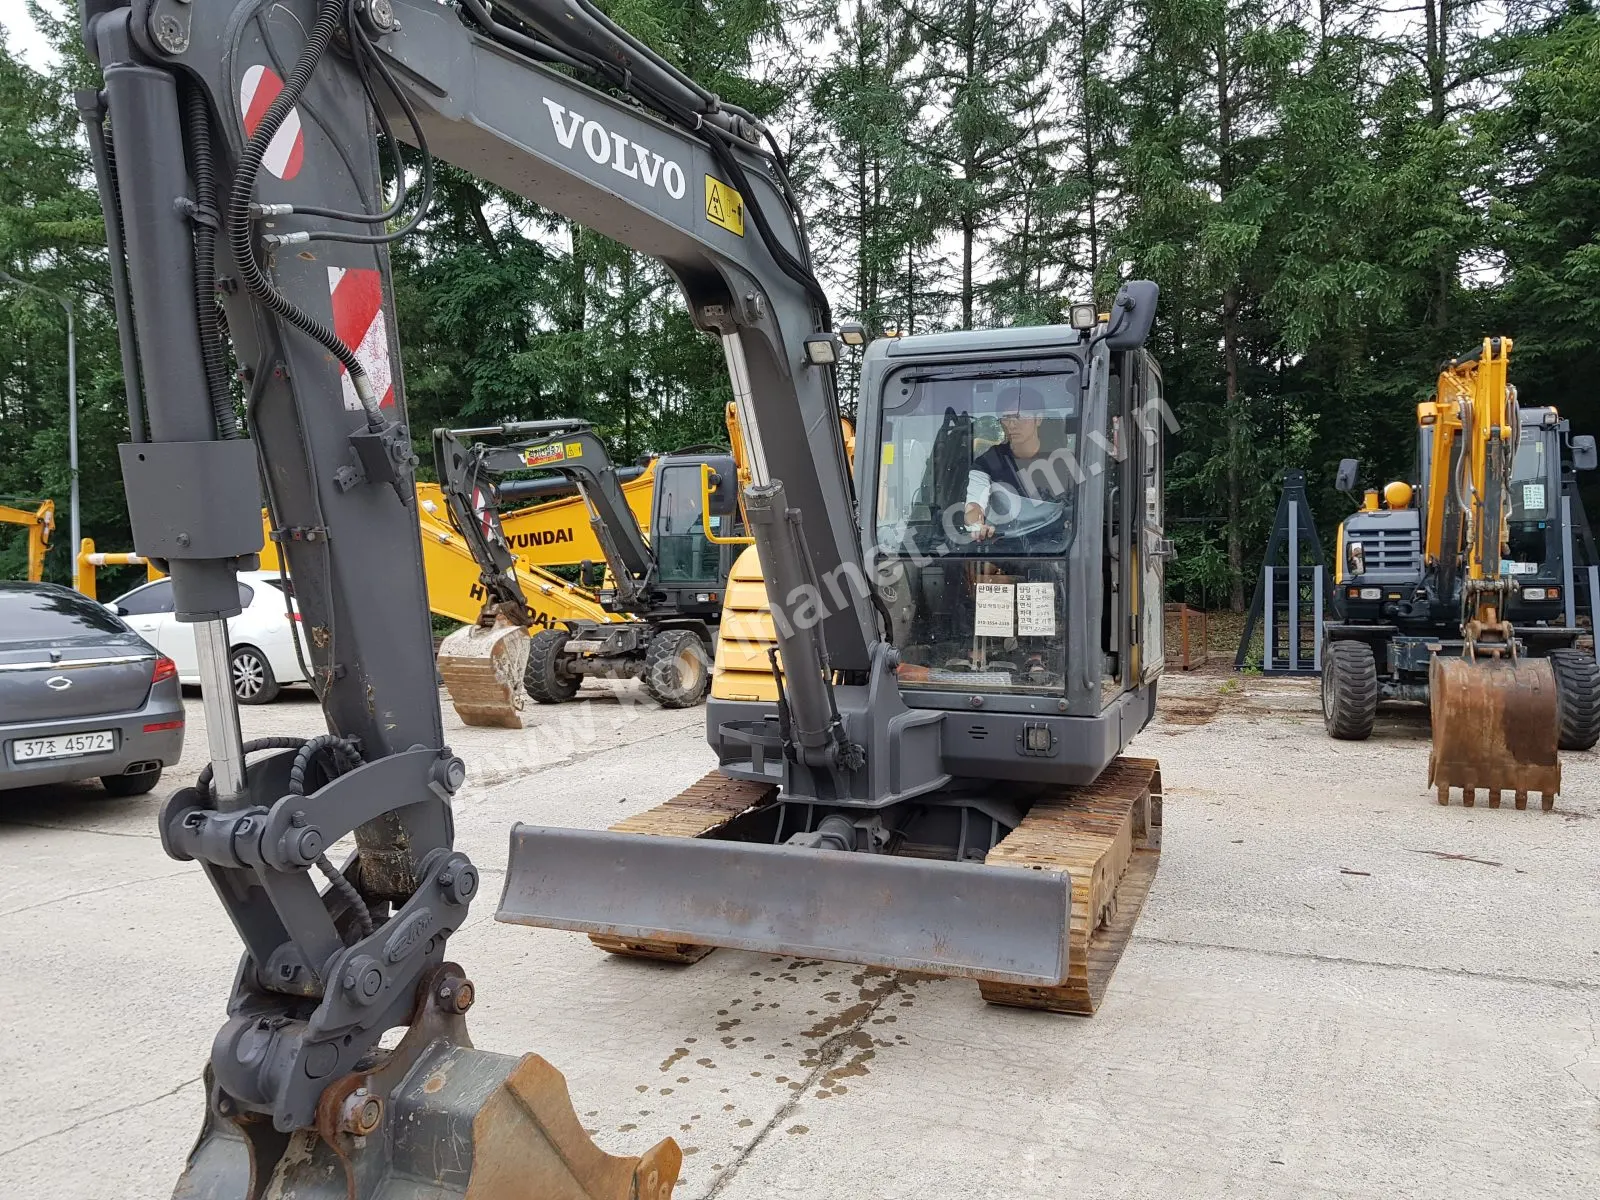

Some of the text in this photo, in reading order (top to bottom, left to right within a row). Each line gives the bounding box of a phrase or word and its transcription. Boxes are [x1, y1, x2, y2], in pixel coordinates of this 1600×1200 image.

[543, 97, 686, 200] VOLVO
[505, 528, 574, 550] YUNDAI
[24, 734, 105, 757] 37조 4572
